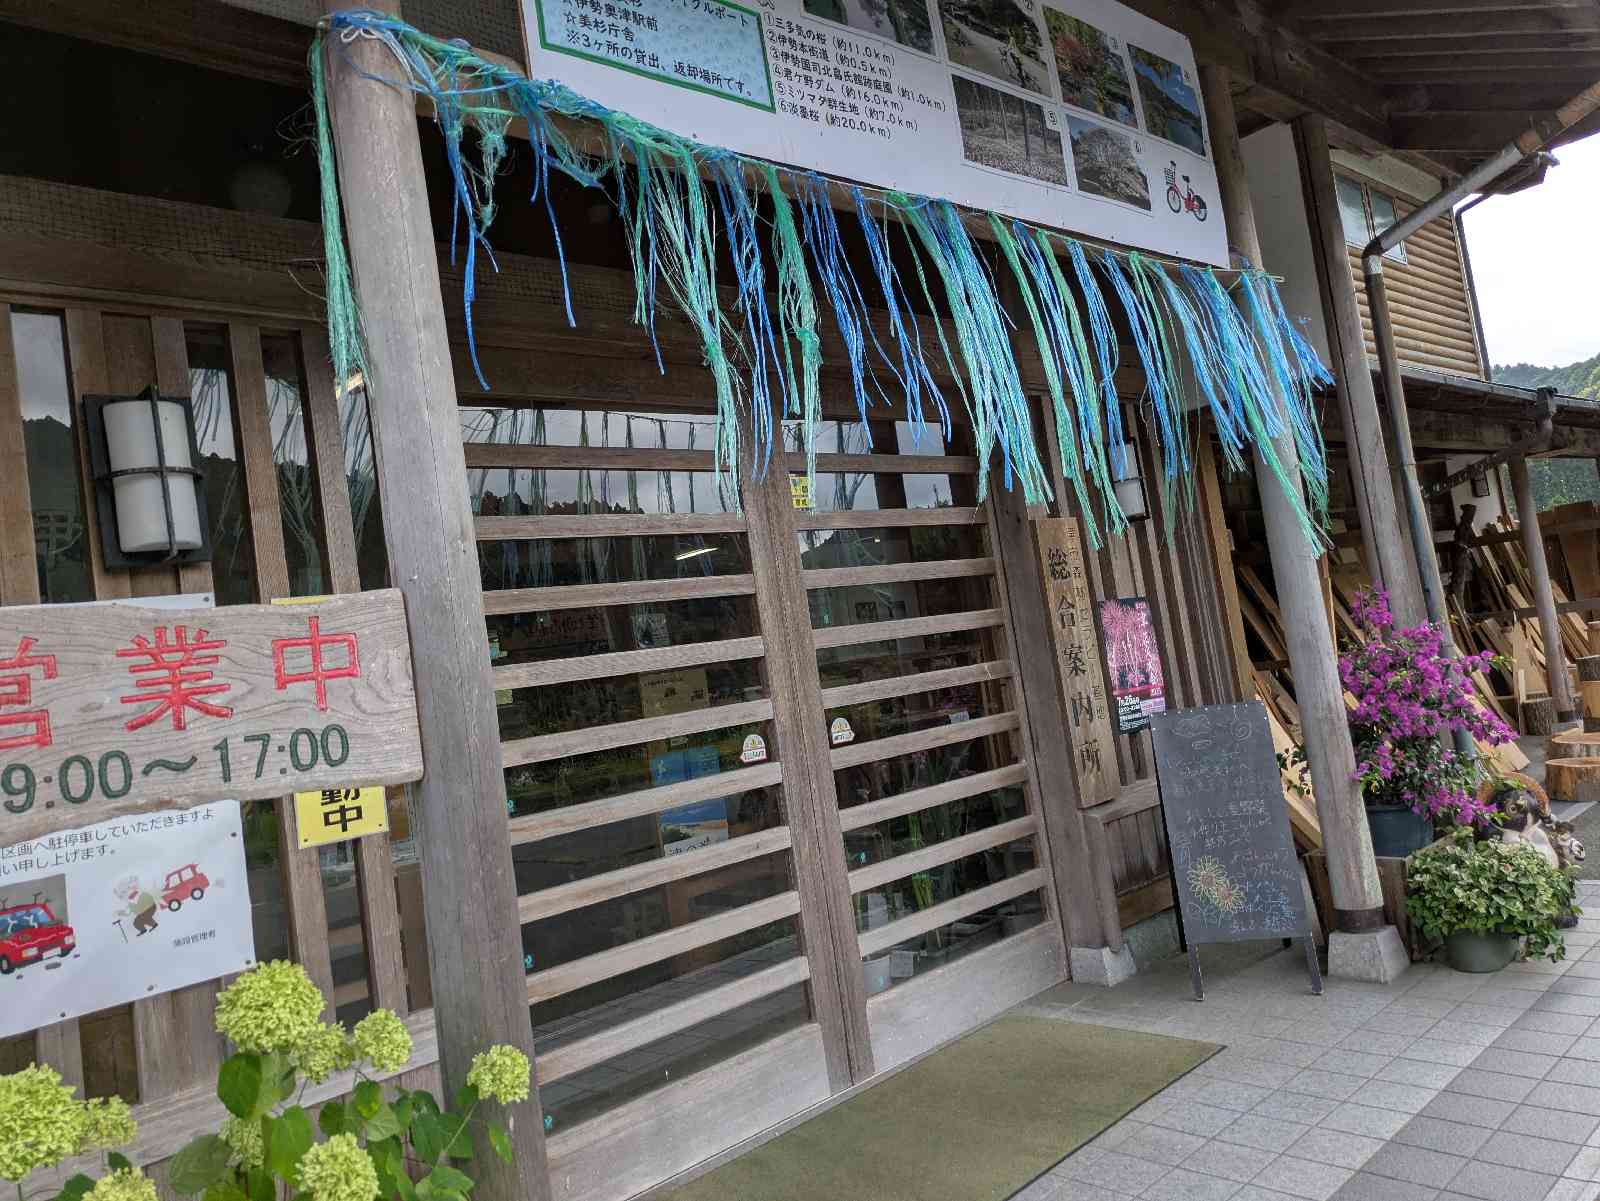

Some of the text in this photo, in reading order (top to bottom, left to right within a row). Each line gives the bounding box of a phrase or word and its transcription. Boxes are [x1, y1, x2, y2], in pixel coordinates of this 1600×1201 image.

[0, 844, 116, 877] い申し上げます。
